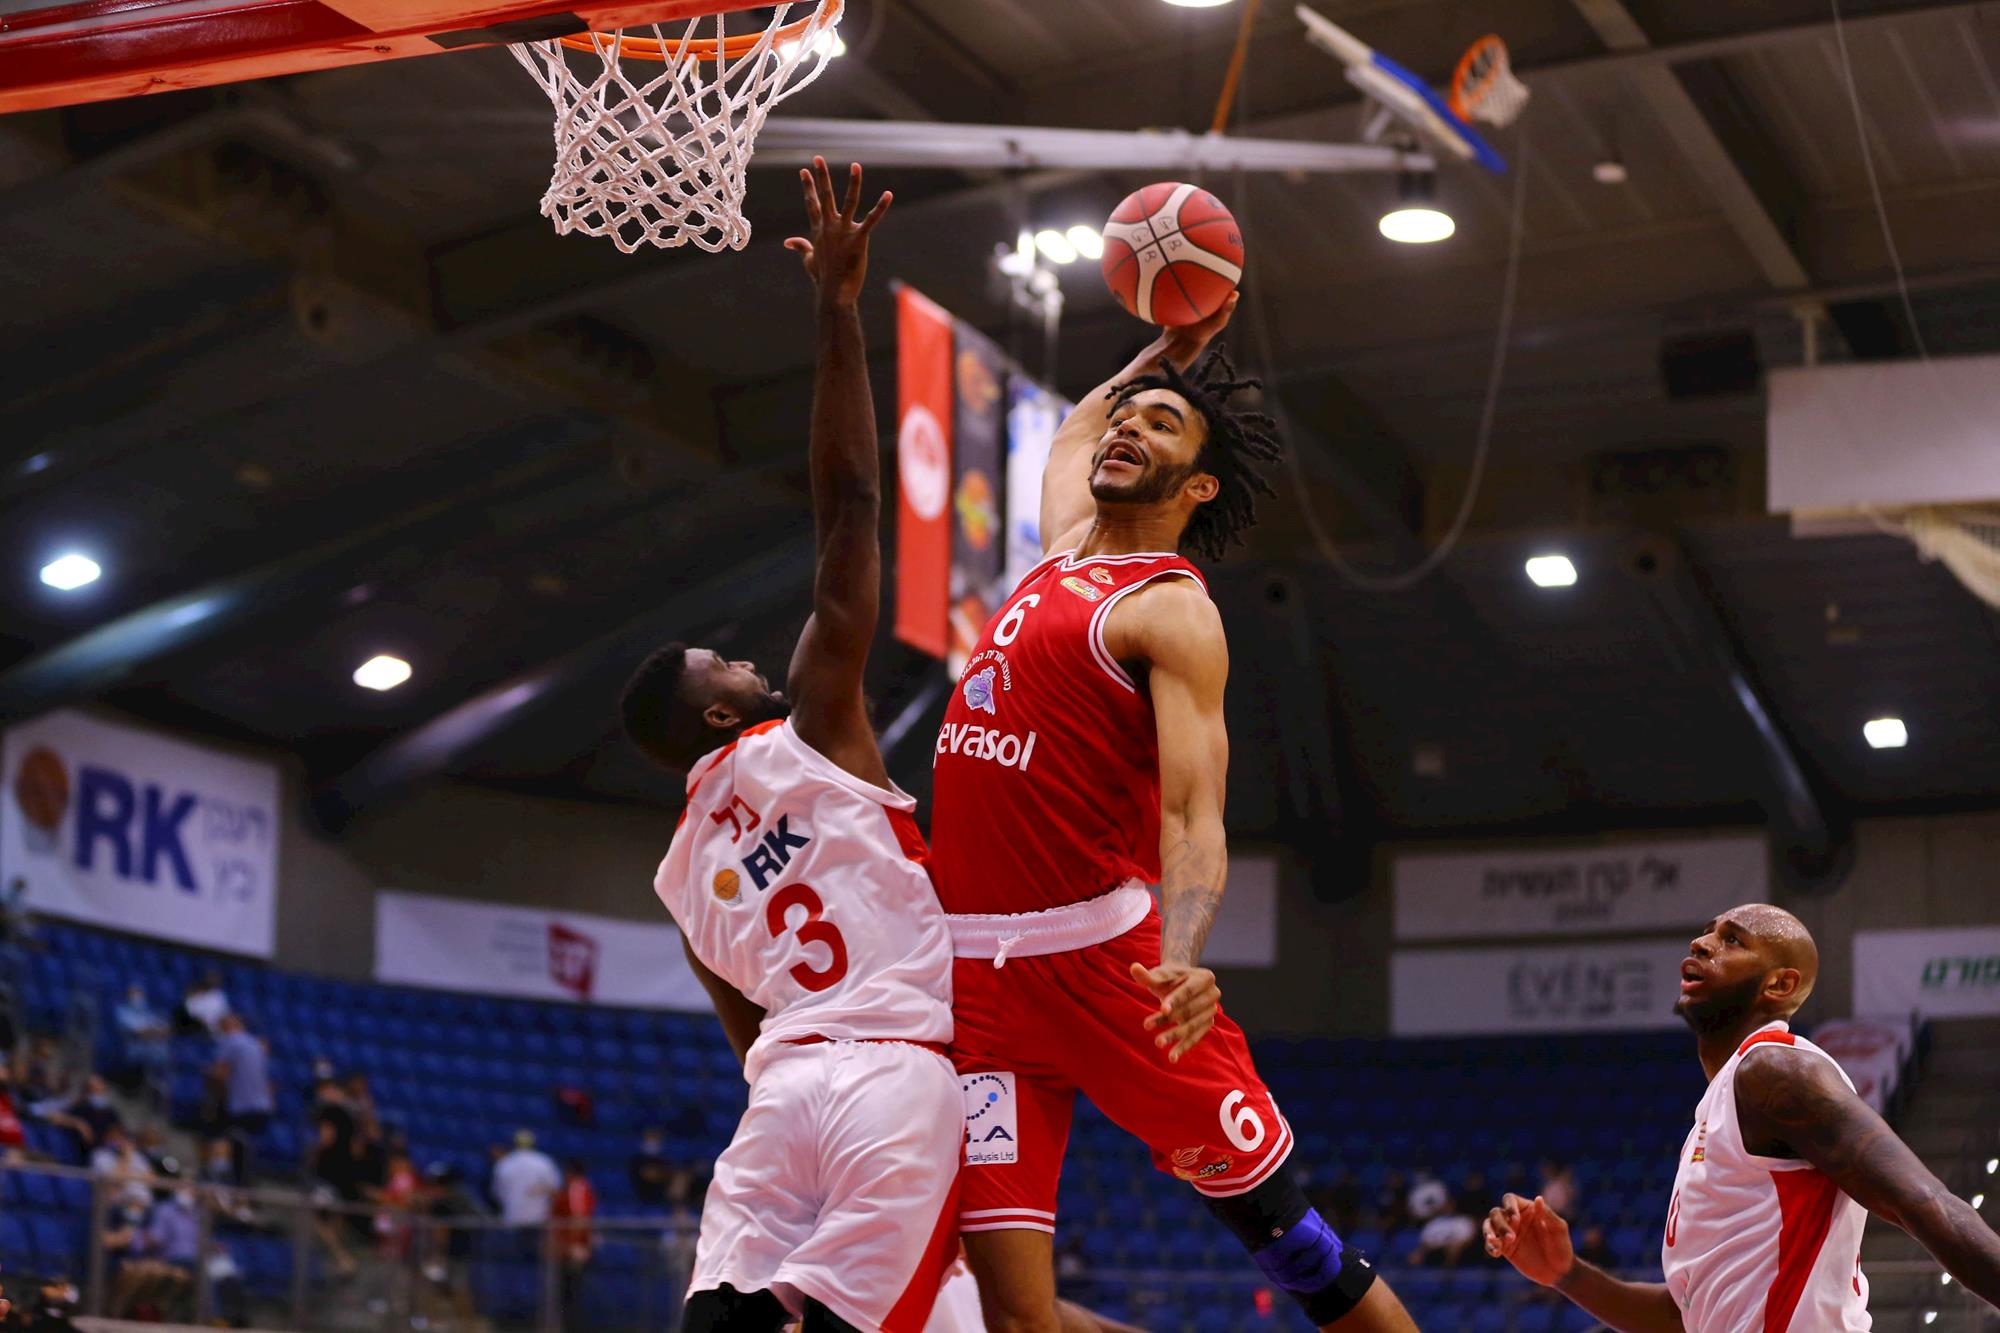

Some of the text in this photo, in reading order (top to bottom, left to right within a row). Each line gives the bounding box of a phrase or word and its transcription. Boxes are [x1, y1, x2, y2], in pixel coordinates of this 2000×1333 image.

[993, 593, 1040, 647] 6
[933, 723, 1037, 772] evasol
[76, 766, 197, 894] RK
[741, 813, 811, 892] RK
[766, 883, 849, 992] 3
[1219, 1089, 1265, 1152] 6
[965, 1152, 999, 1163] nalysis
